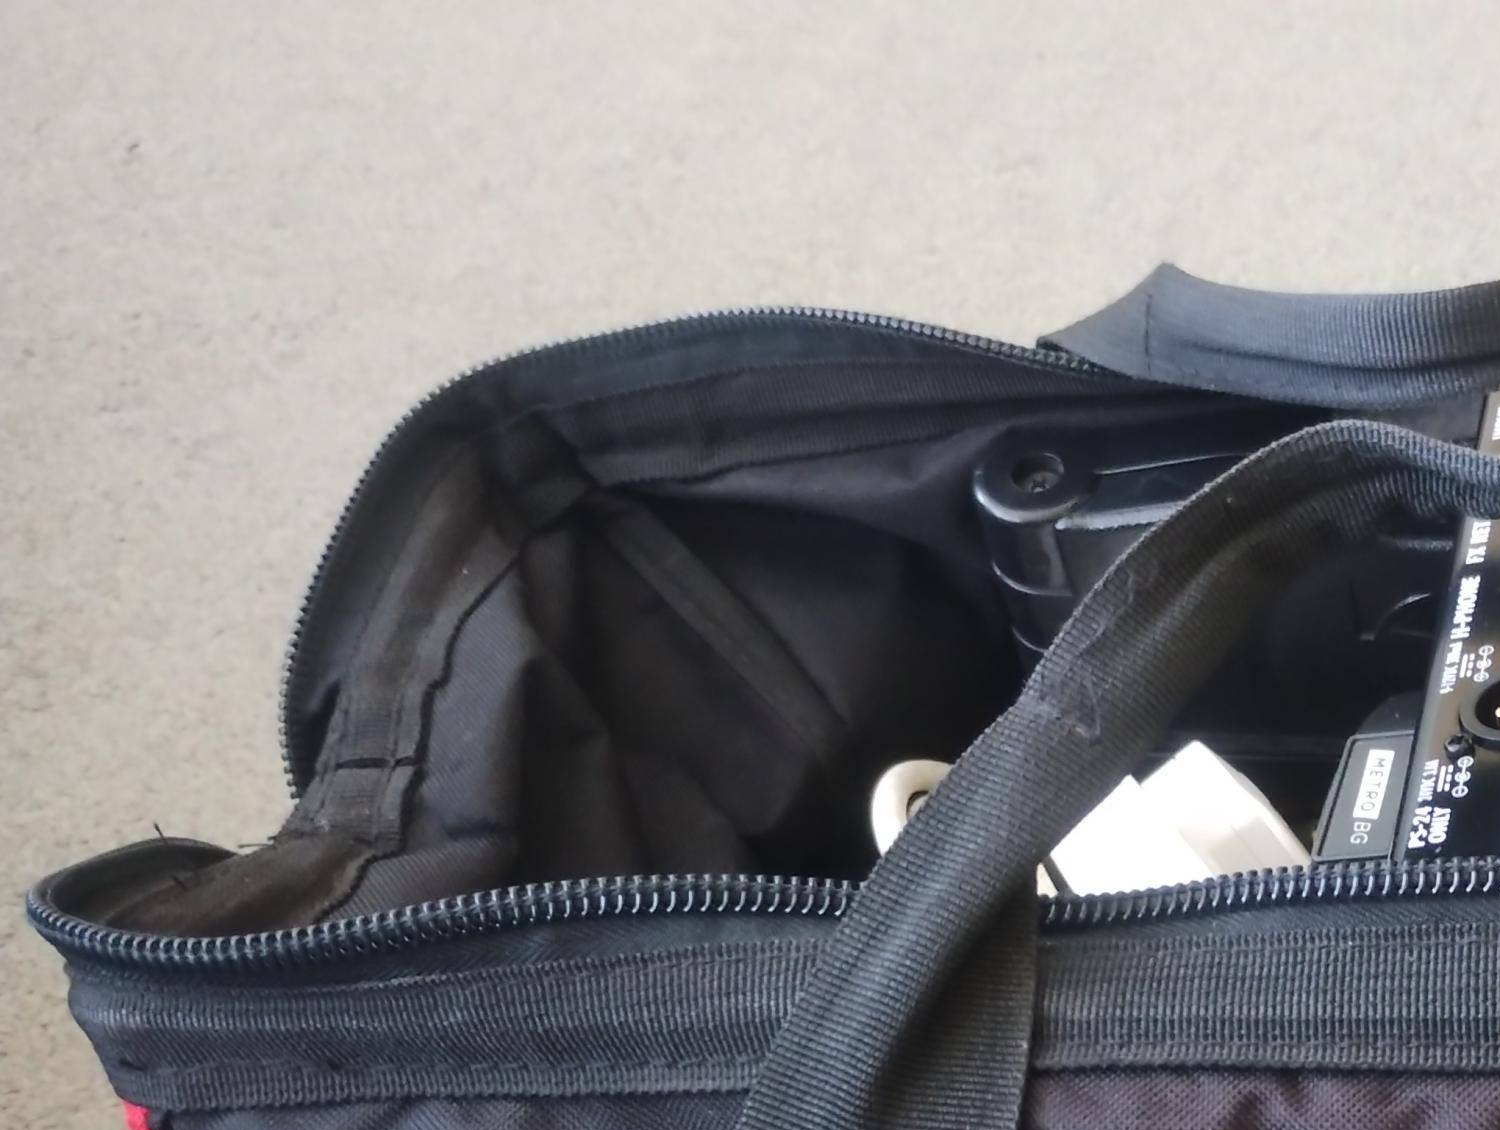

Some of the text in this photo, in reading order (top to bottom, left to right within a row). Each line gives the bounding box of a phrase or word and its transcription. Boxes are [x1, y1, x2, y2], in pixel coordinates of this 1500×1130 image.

[1465, 545, 1486, 565] FX
[1450, 575, 1481, 639] H-PHONE
[1350, 757, 1387, 844] METRO BG
[1408, 806, 1432, 849] PS-24
[1428, 807, 1451, 844] ONLY
